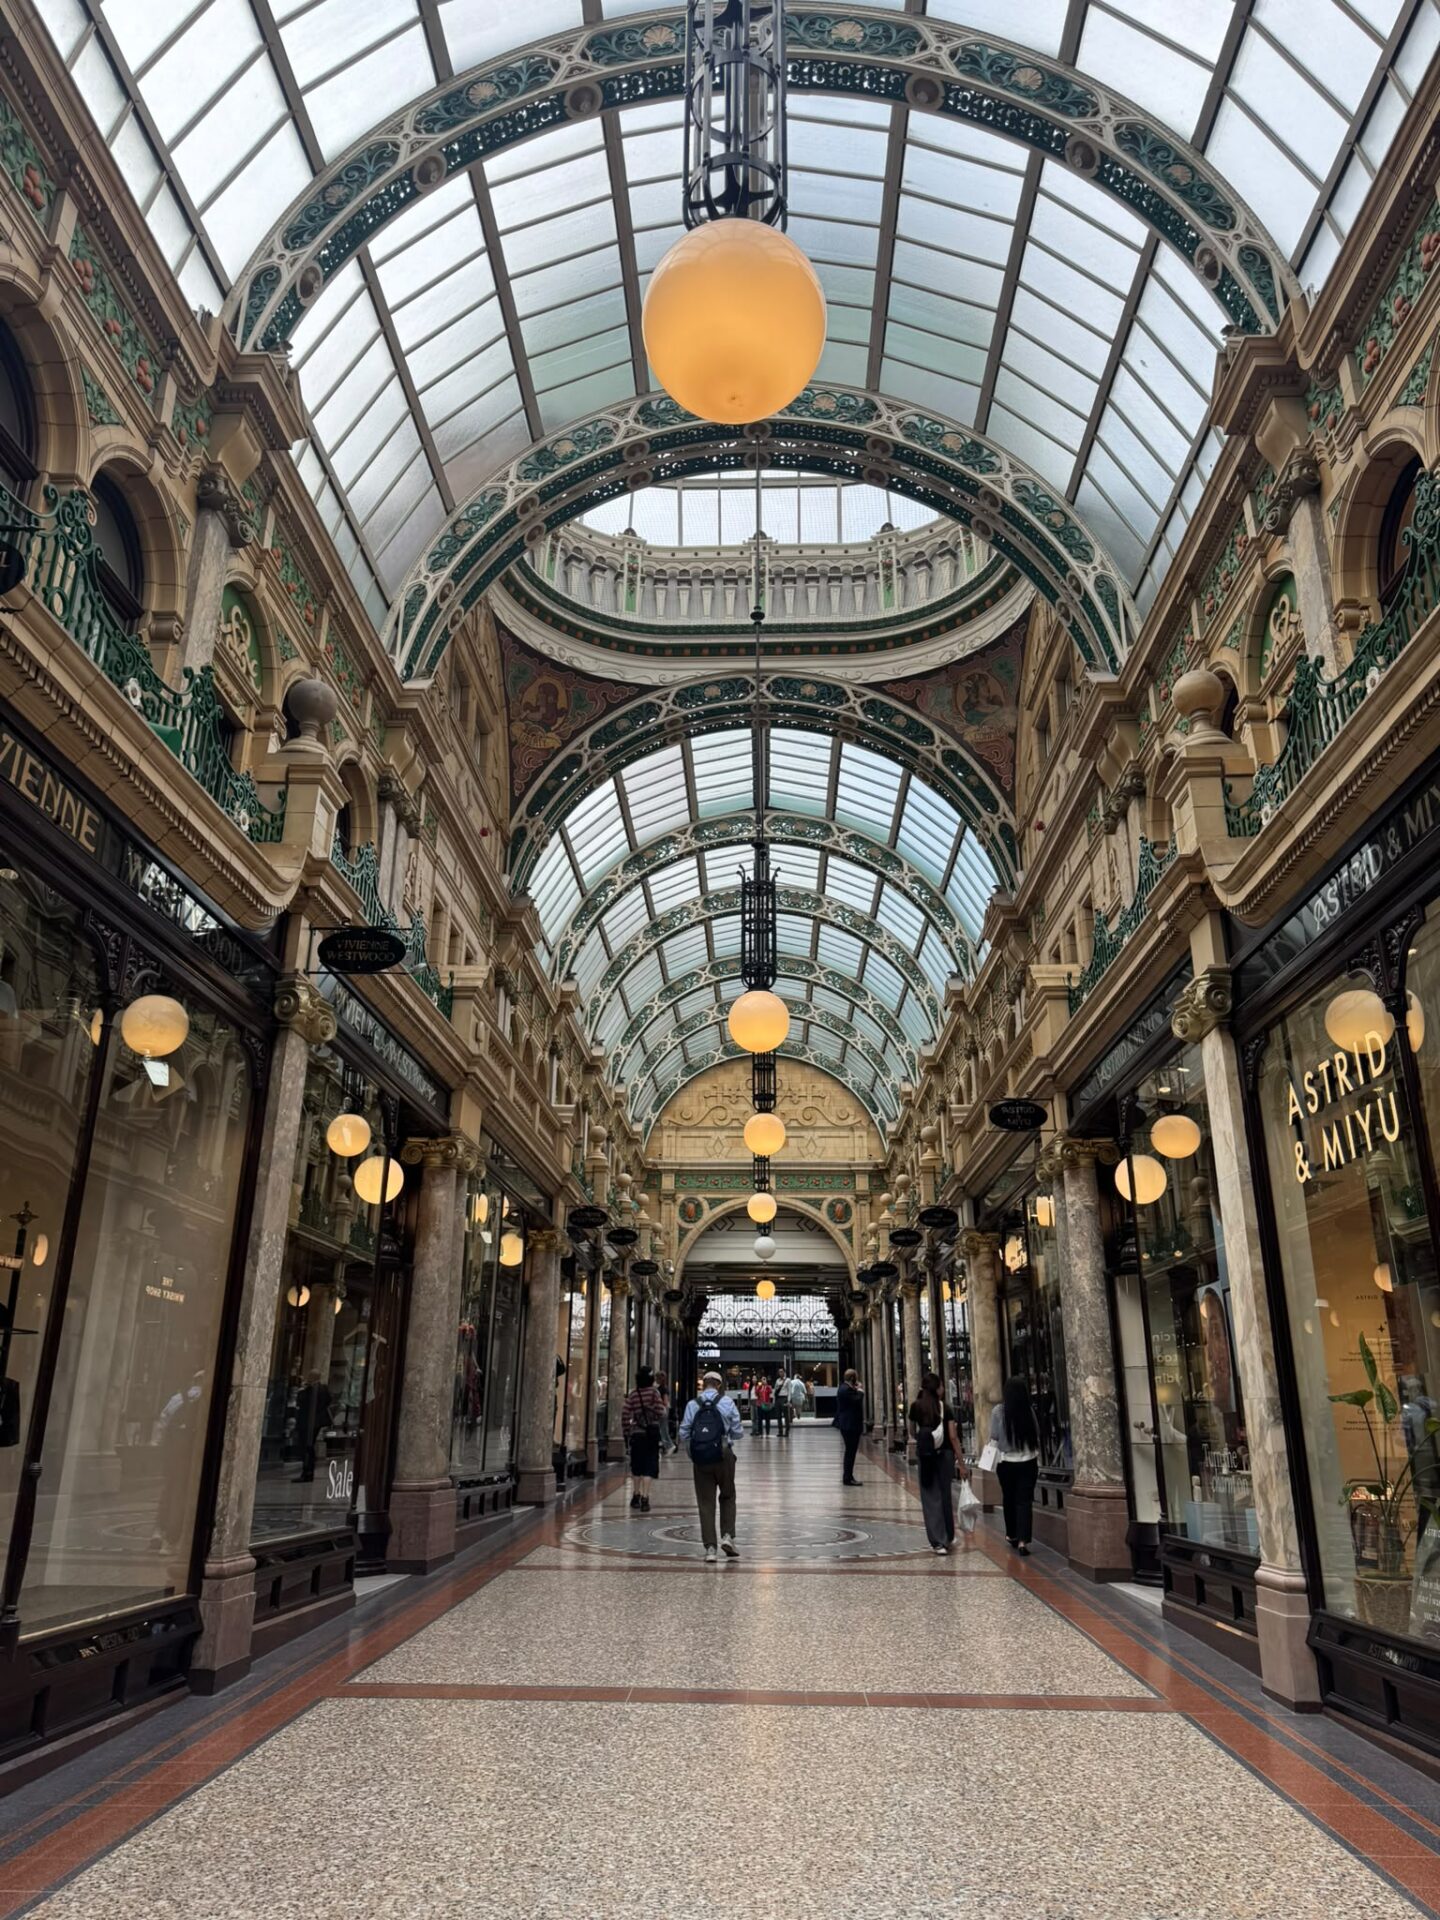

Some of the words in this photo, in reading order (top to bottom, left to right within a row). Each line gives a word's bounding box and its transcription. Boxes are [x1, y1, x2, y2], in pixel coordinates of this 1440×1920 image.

[1314, 841, 1384, 931] ASTRID
[1387, 826, 1403, 863] &
[326, 950, 396, 963] WESTWOOD
[336, 939, 391, 951] VIVIENNE
[1289, 1030, 1386, 1126] ASTRID
[1294, 1140, 1312, 1184] &
[1321, 1091, 1399, 1173] MIYU
[326, 1458, 354, 1499] Sale
